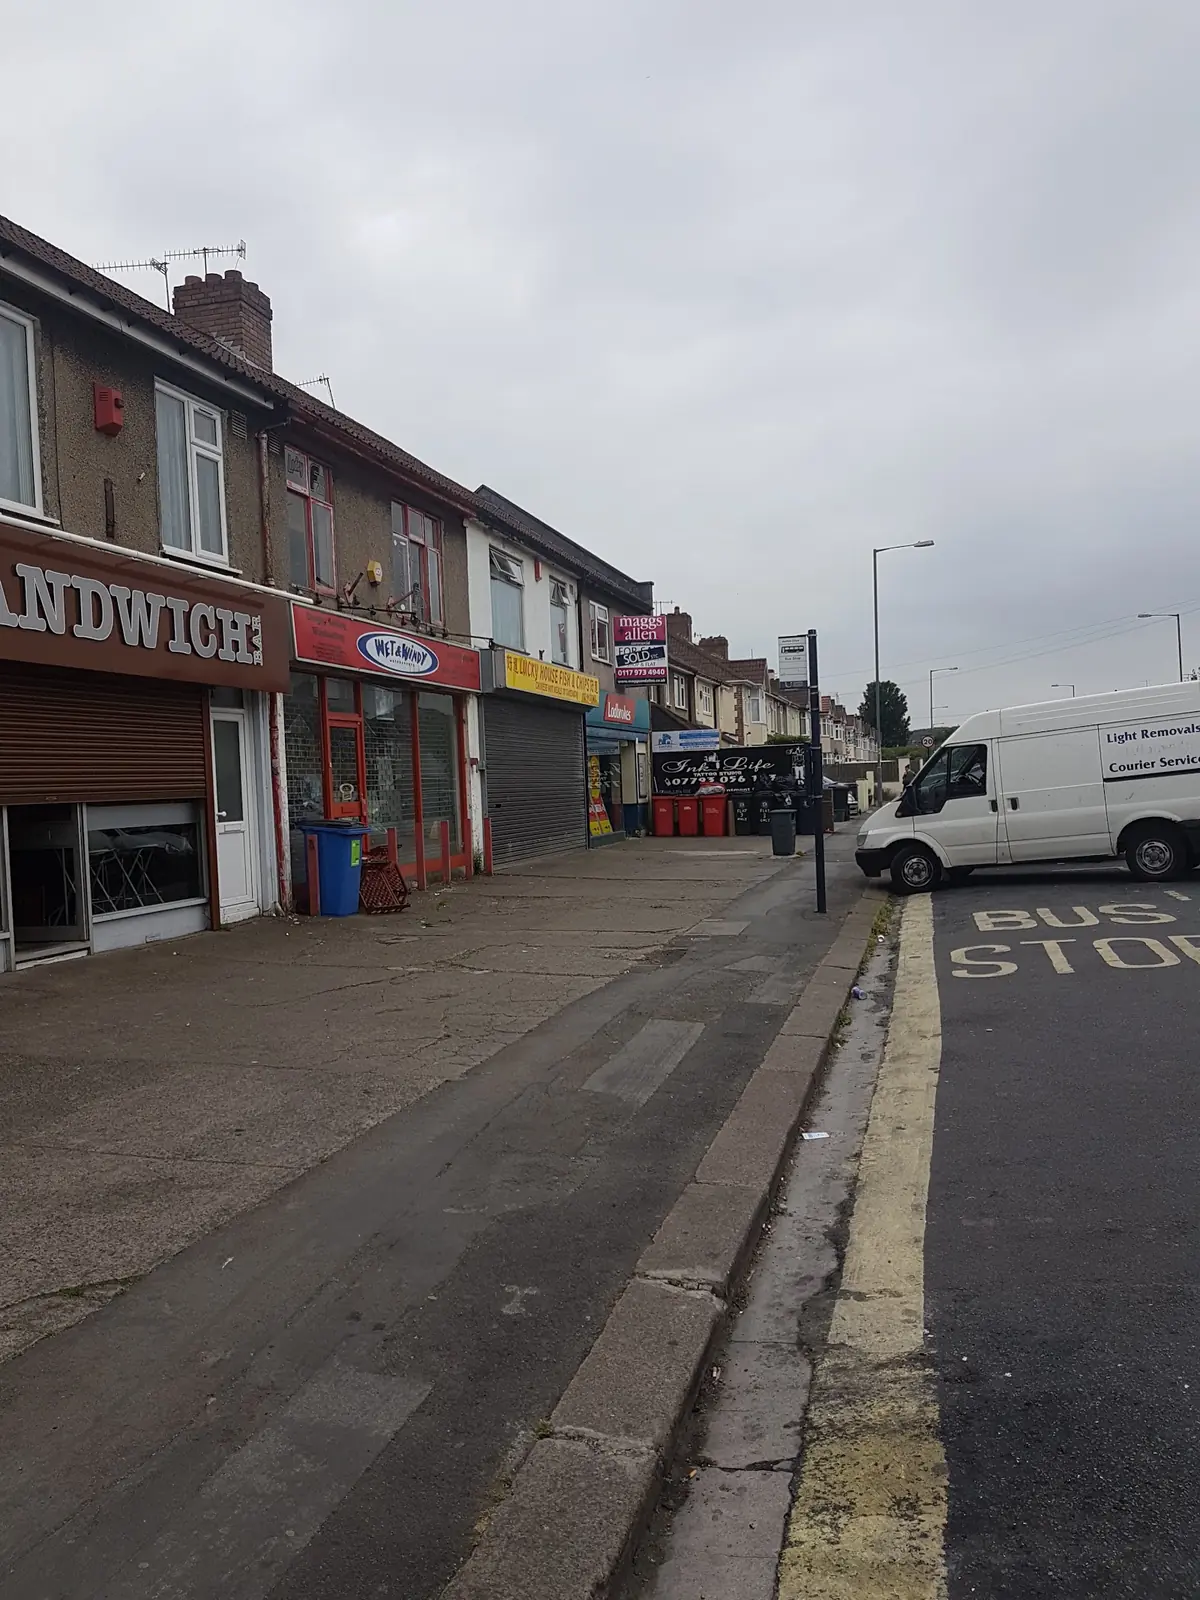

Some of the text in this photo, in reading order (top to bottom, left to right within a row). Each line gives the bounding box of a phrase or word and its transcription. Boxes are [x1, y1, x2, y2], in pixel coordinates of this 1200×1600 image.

[619, 617, 663, 630] maggs
[252, 615, 264, 666] BAR
[624, 627, 657, 640] allen
[623, 650, 650, 664] SOLD
[540, 665, 558, 683] HOUSE
[559, 669, 571, 687] FISH
[576, 674, 589, 691] CHIPS
[607, 701, 631, 720] Ladbrokes
[1106, 724, 1200, 744] Light Removals
[661, 759, 714, 774] Ink
[722, 756, 775, 772] Life
[1109, 760, 1156, 772] Courier
[671, 776, 715, 785] 07793
[719, 775, 746, 783] 056
[973, 903, 1177, 931] BUS
